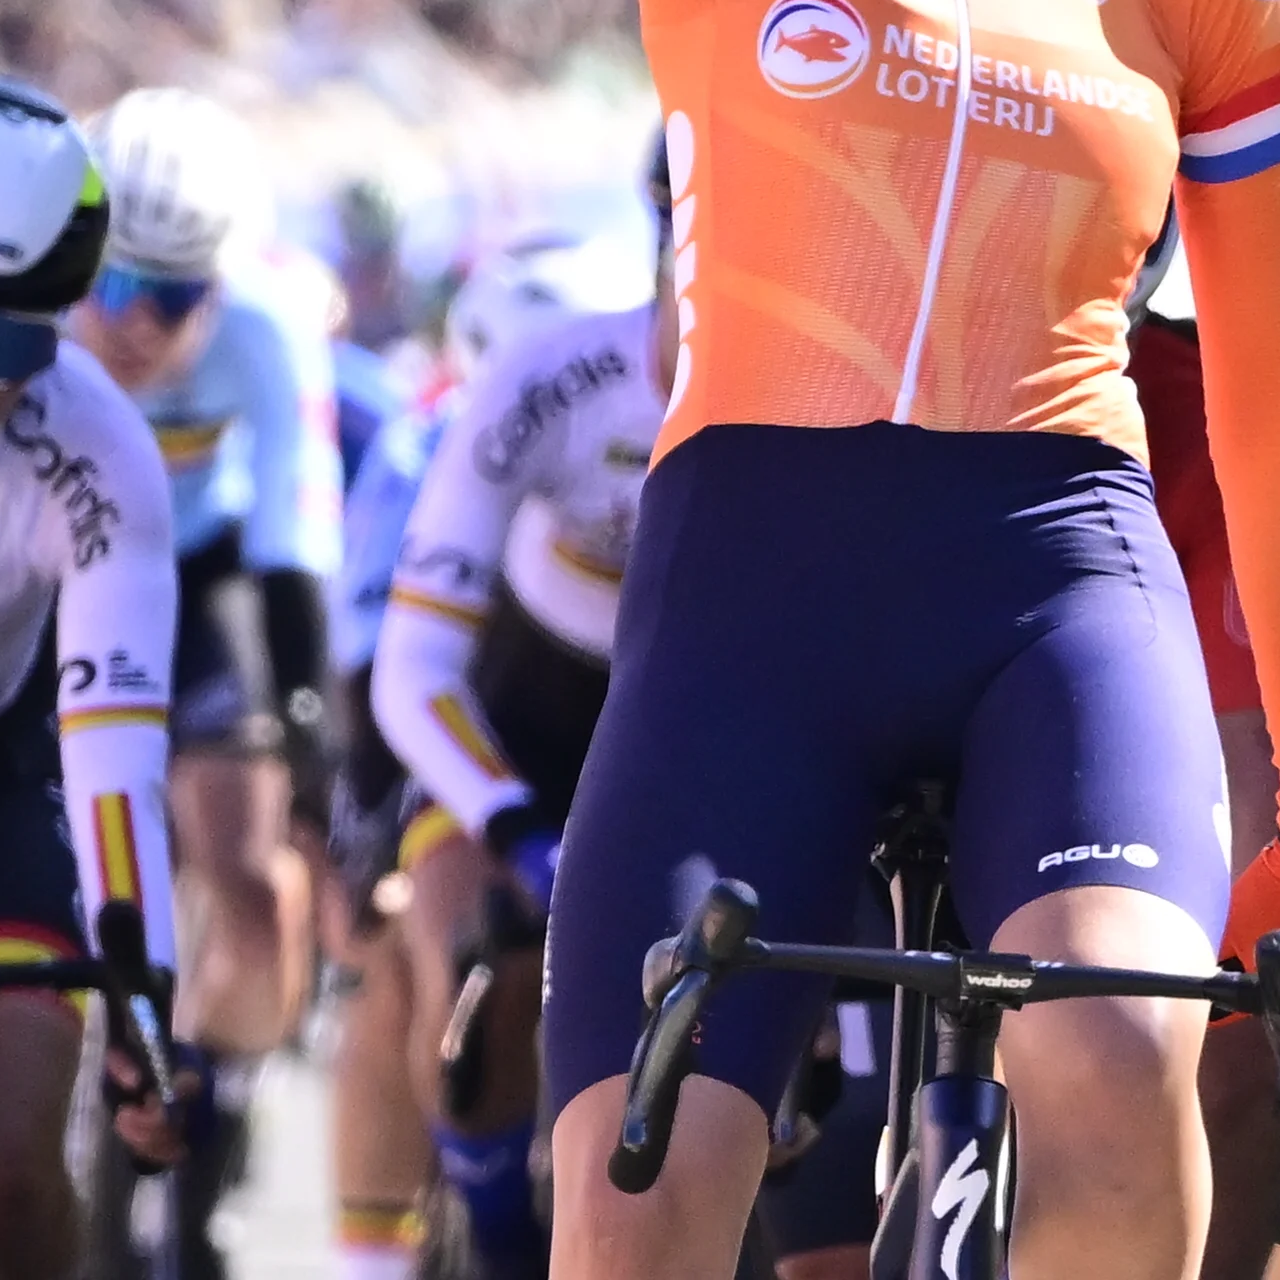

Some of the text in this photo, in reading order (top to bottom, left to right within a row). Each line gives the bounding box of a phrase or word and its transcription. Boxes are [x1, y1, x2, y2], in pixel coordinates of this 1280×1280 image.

[882, 22, 1156, 121] NEDERLANDSE
[874, 62, 1057, 138] LOTERIJ
[1037, 843, 1122, 872] AGU
[966, 973, 1034, 990] wahoo
